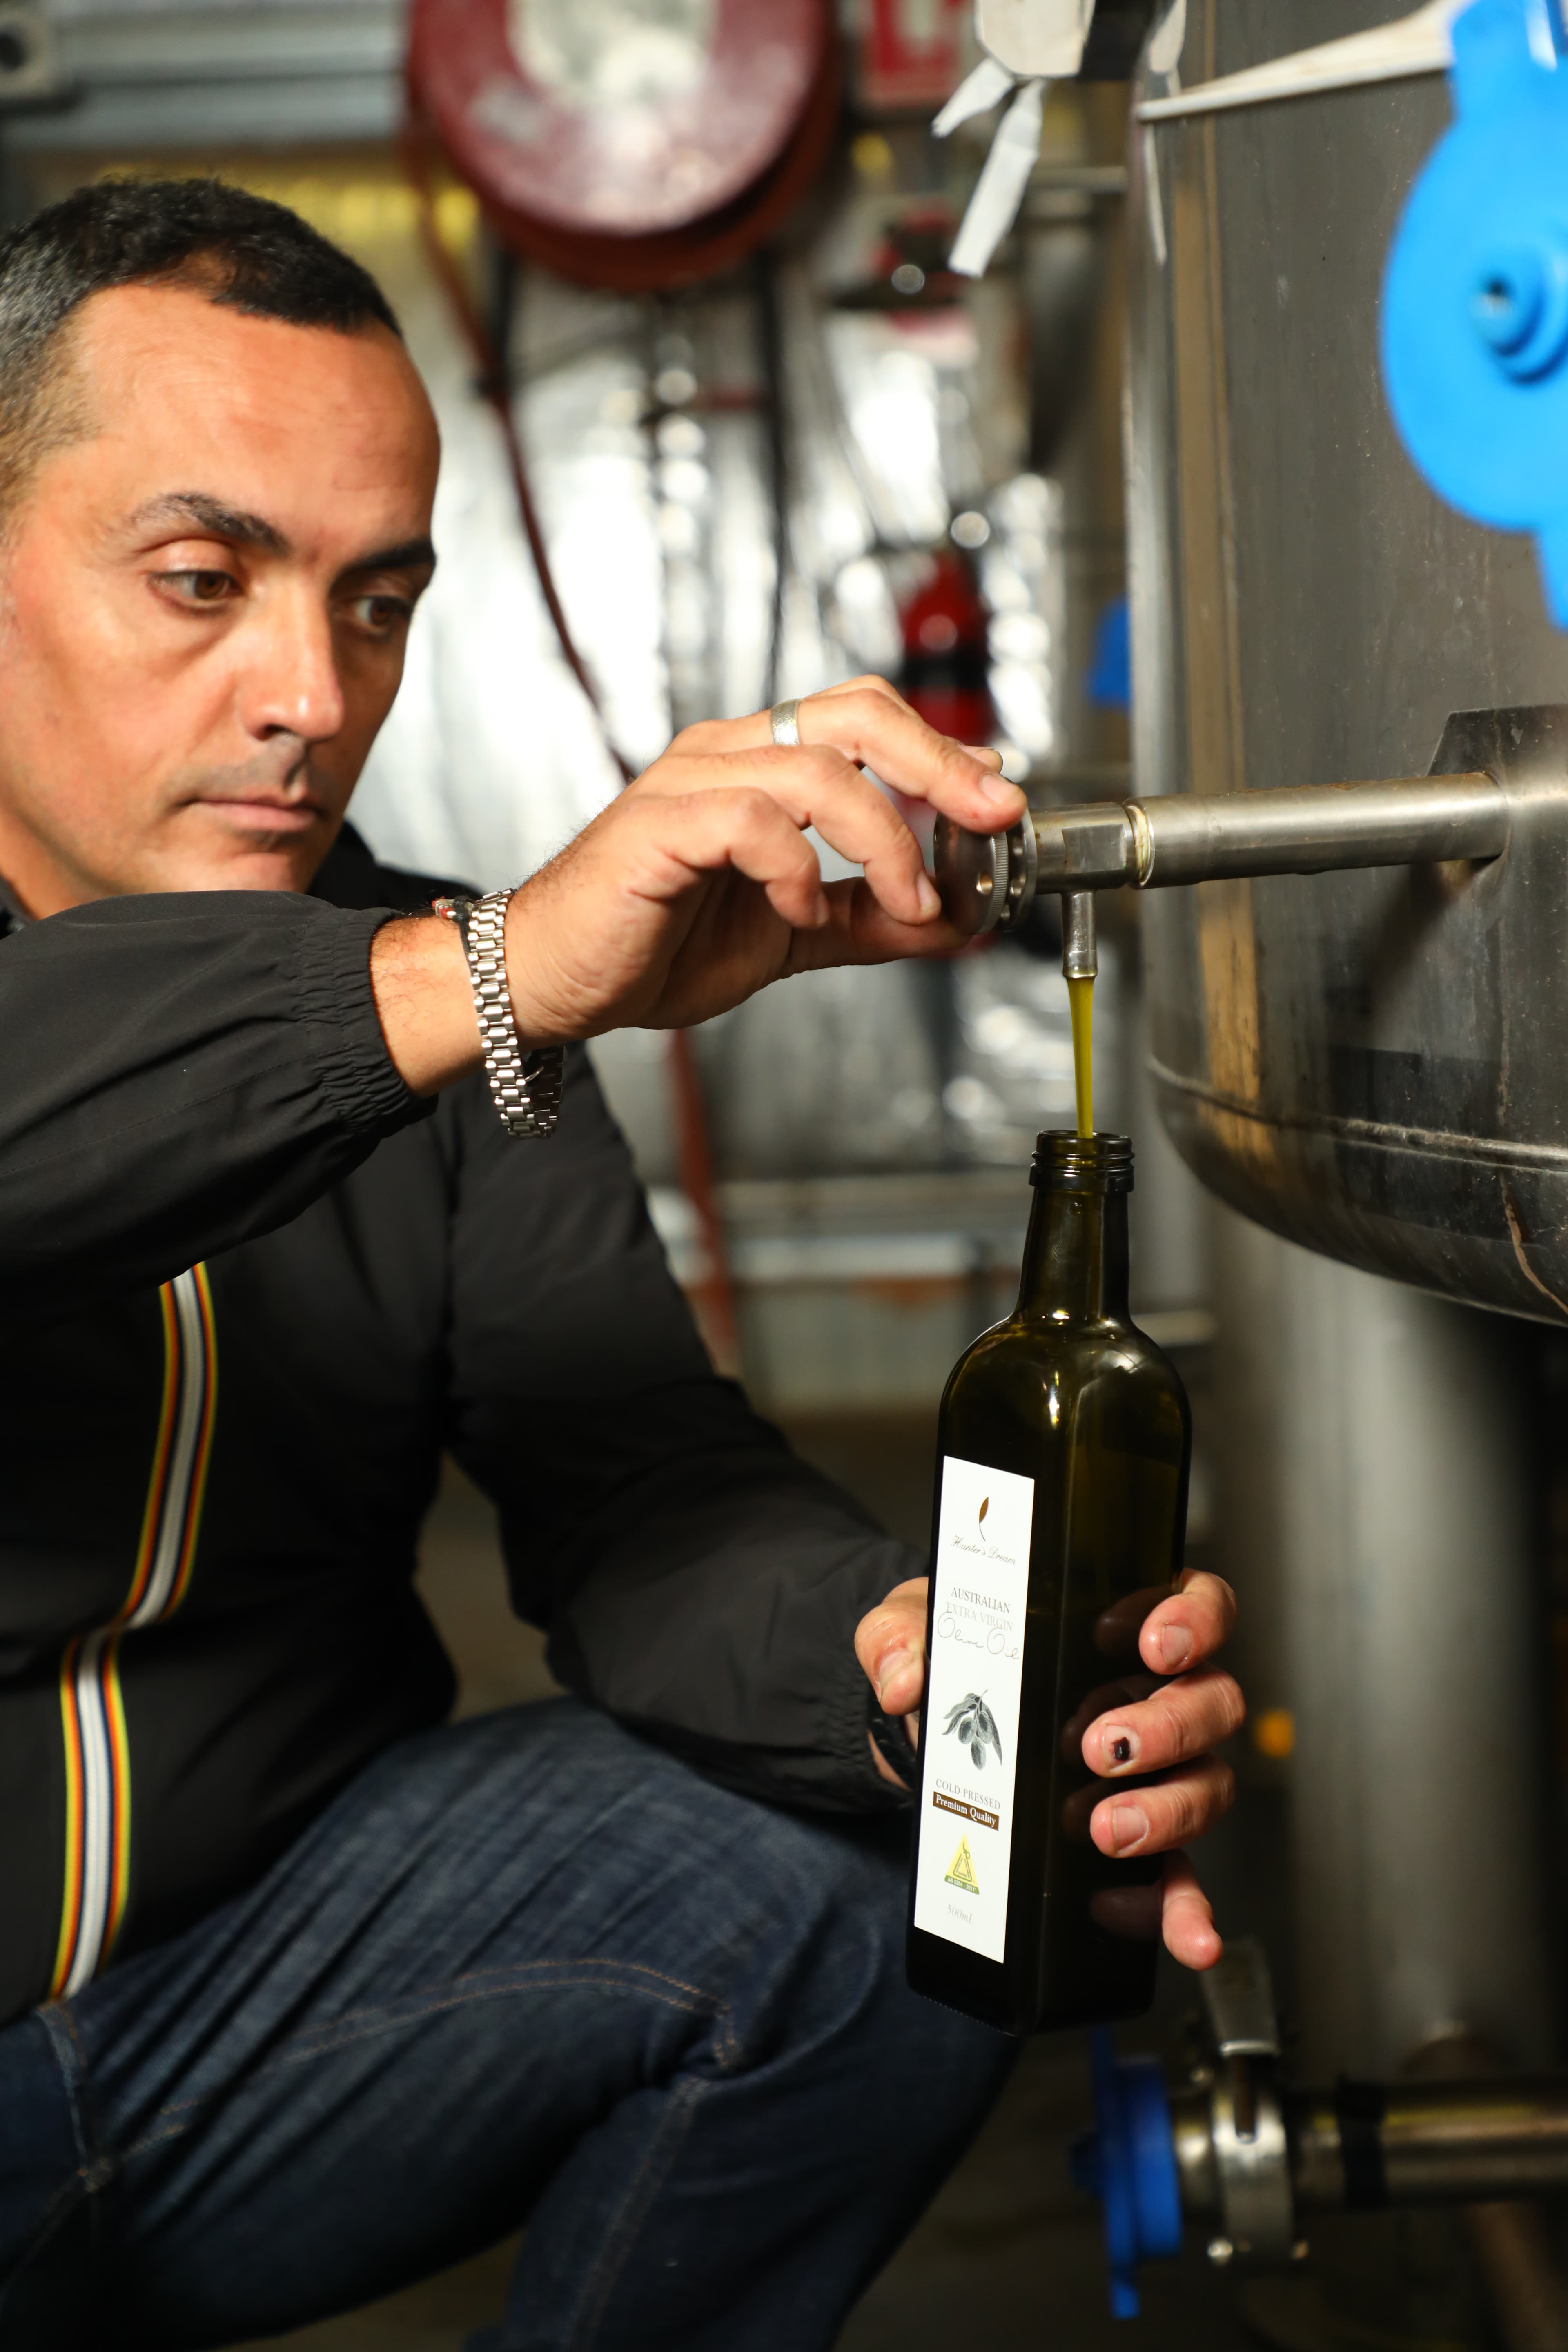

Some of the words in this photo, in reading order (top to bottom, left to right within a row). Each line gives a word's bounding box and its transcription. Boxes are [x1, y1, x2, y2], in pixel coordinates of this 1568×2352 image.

[950, 1535, 986, 1556] Hunter's
[988, 1546, 1016, 1565] Dream
[951, 1587, 1010, 1613] AUSTRALIAN
[947, 1601, 977, 1621] EXTRA
[980, 1612, 1013, 1632] VIRGIN
[938, 1611, 984, 1648] Olive
[987, 1628, 1019, 1659] Oil
[936, 1778, 1000, 1810] COLD-PRESSED
[936, 1794, 967, 1815] Premium
[970, 1807, 996, 1827] Quality
[947, 1904, 974, 1924] 500mL
